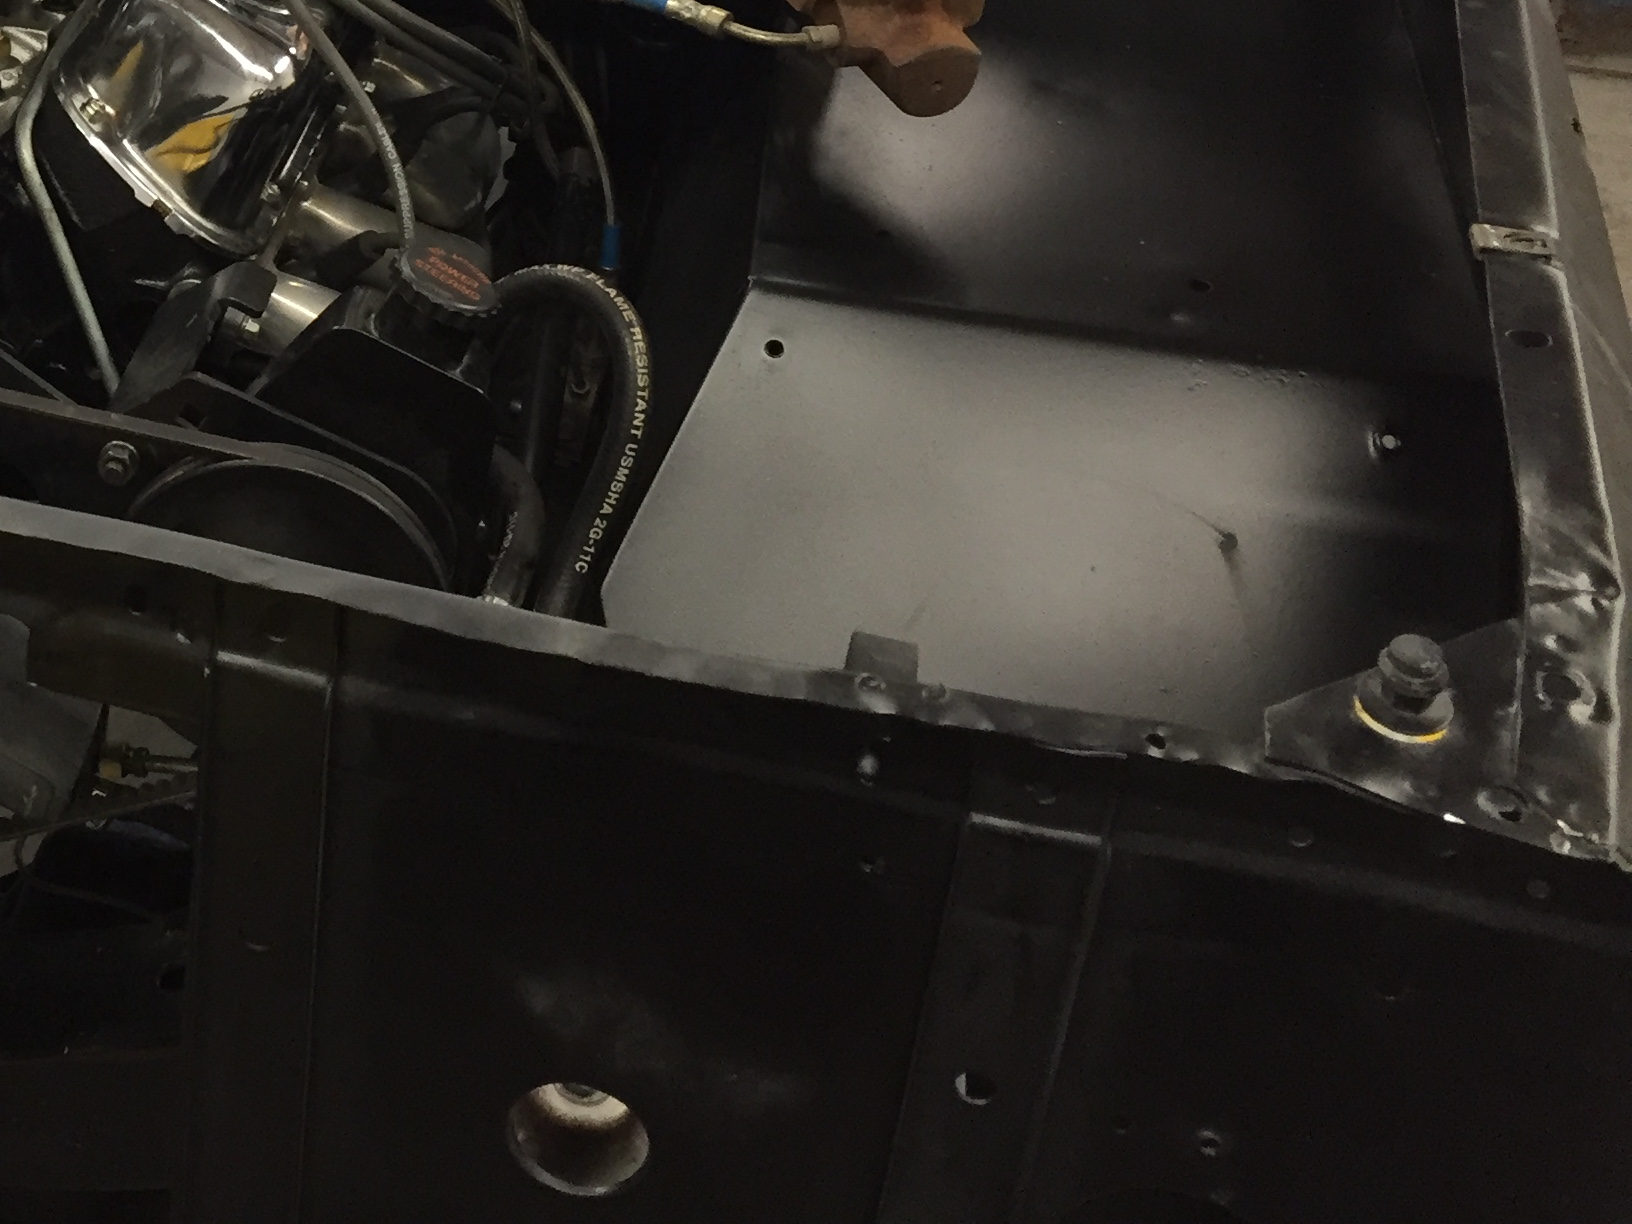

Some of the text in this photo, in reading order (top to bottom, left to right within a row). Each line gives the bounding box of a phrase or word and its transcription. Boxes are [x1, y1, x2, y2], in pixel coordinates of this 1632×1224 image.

[628, 326, 651, 439] RESISTANT
[599, 442, 639, 516] USMSHA
[574, 518, 608, 575] 2G-11C
